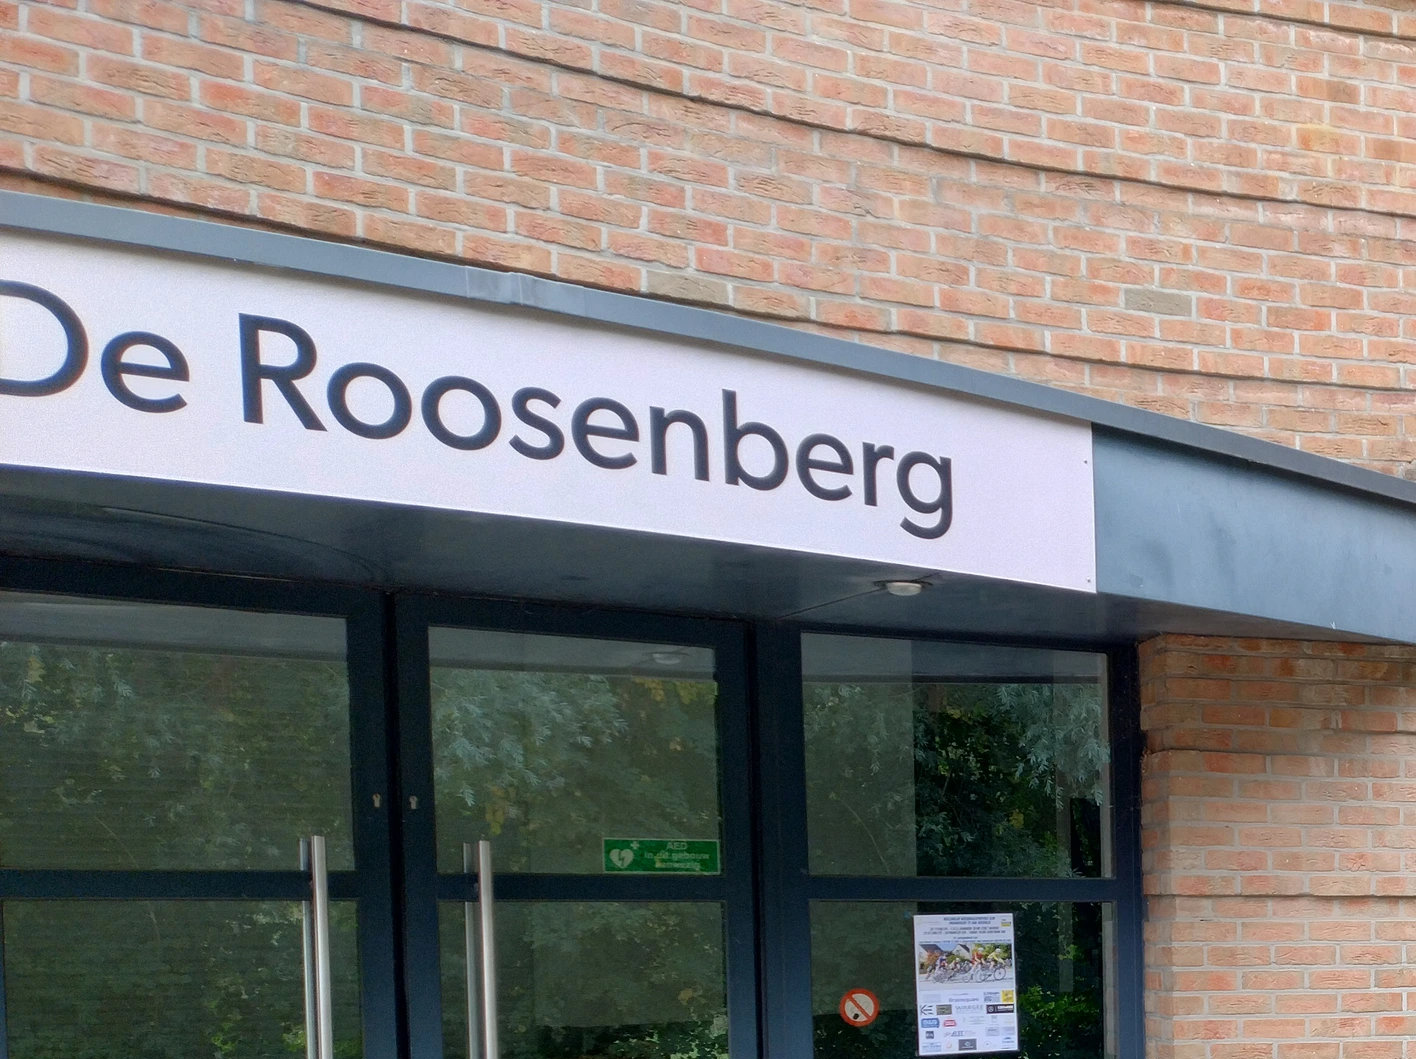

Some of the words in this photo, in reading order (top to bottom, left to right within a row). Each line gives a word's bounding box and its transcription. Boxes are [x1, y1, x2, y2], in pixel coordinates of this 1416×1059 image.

[0, 278, 190, 413] De
[238, 313, 954, 540] Roosenberg
[666, 842, 688, 850] AED
[672, 851, 710, 861] gebouw
